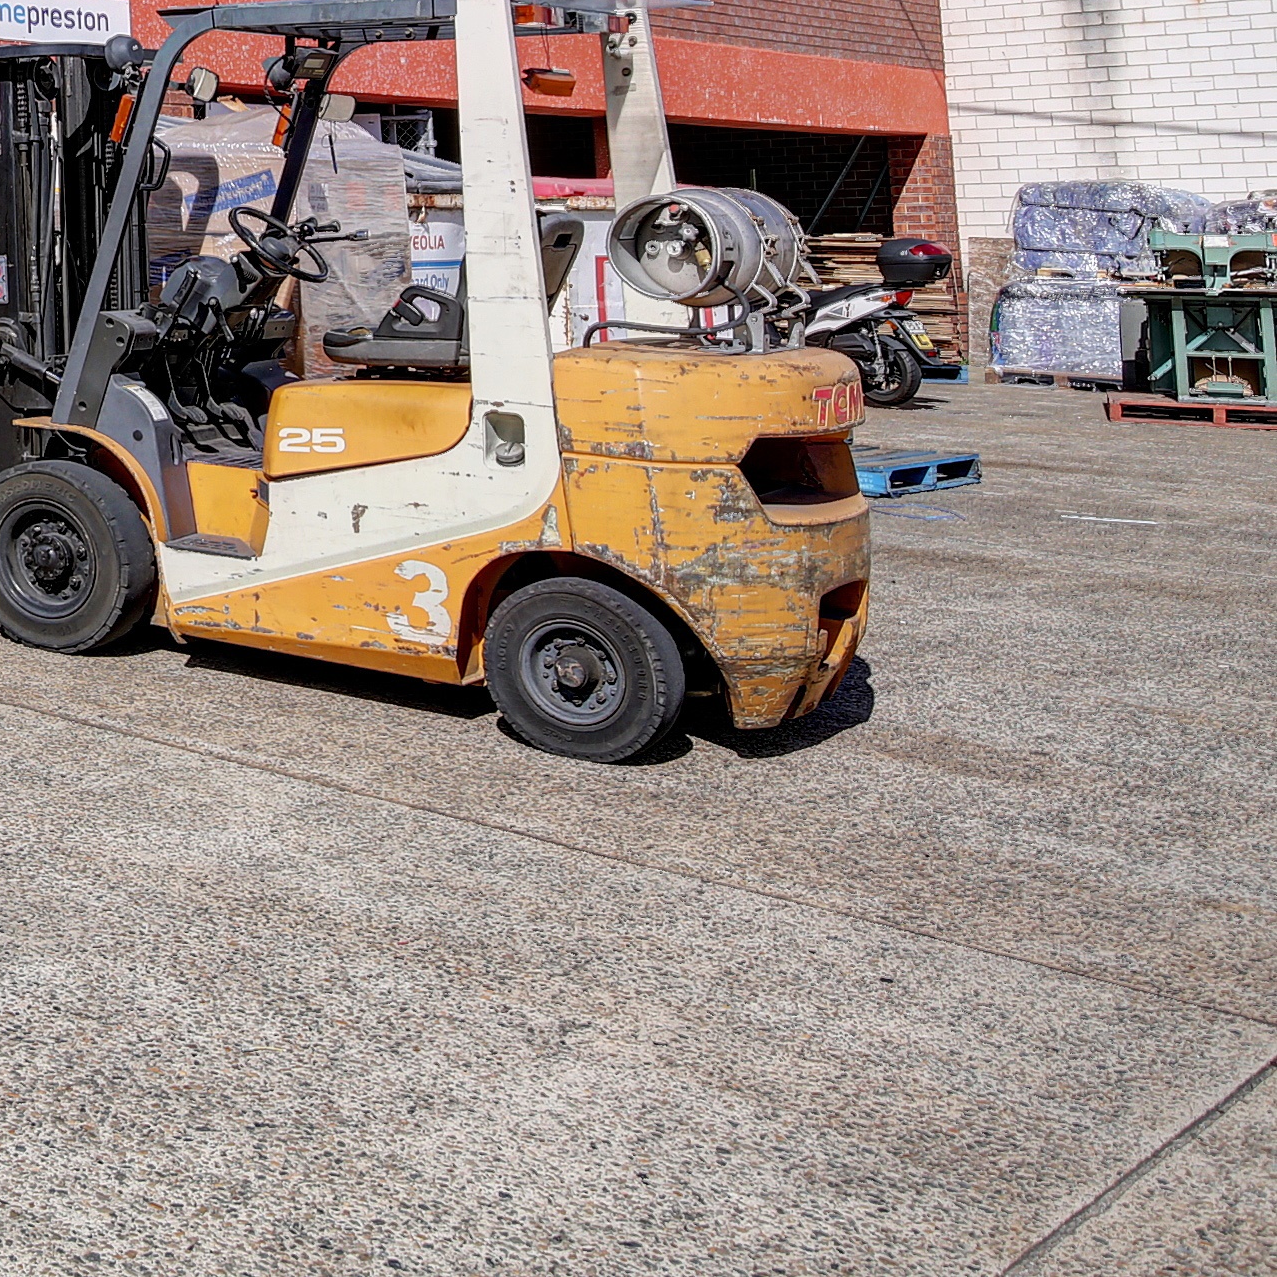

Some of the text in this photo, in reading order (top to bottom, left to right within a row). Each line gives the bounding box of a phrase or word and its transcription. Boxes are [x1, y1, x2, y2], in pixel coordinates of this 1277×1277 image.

[430, 273, 450, 294] Only
[813, 382, 865, 429] TCM
[277, 426, 346, 453] 25
[385, 559, 452, 645] 3
